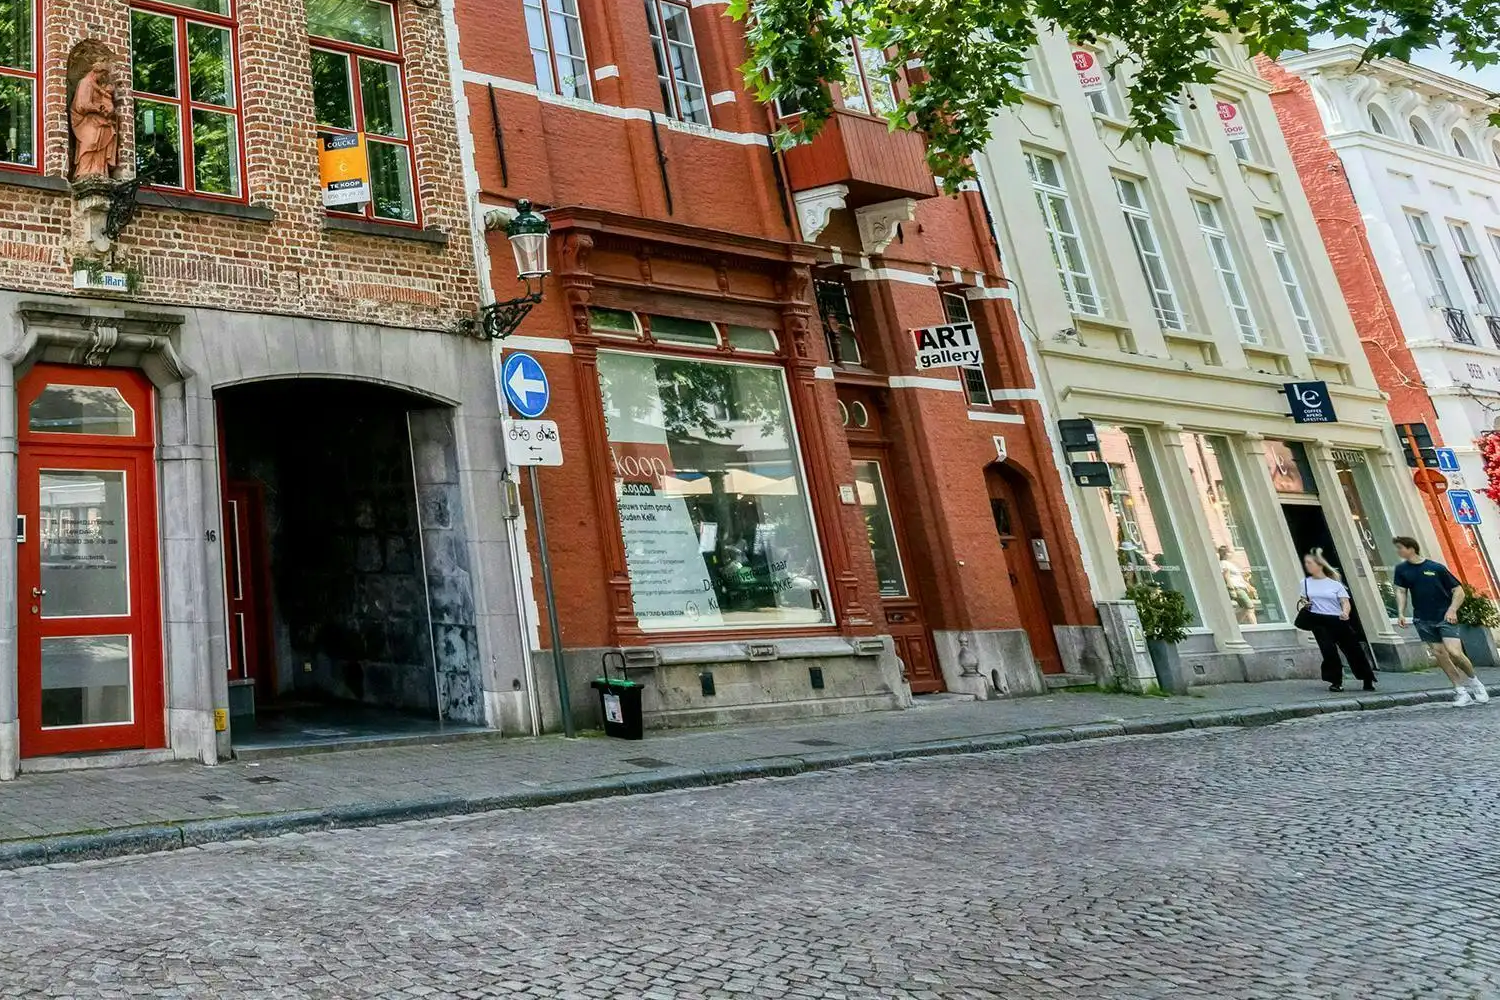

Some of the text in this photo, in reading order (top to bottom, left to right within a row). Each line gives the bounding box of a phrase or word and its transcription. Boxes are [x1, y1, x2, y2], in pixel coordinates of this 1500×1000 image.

[327, 139, 356, 149] COUCKE
[329, 180, 360, 190] TE KOOP
[918, 324, 973, 350] ART
[920, 350, 980, 369] gallery
[609, 446, 666, 488] koop
[205, 530, 216, 542] 16
